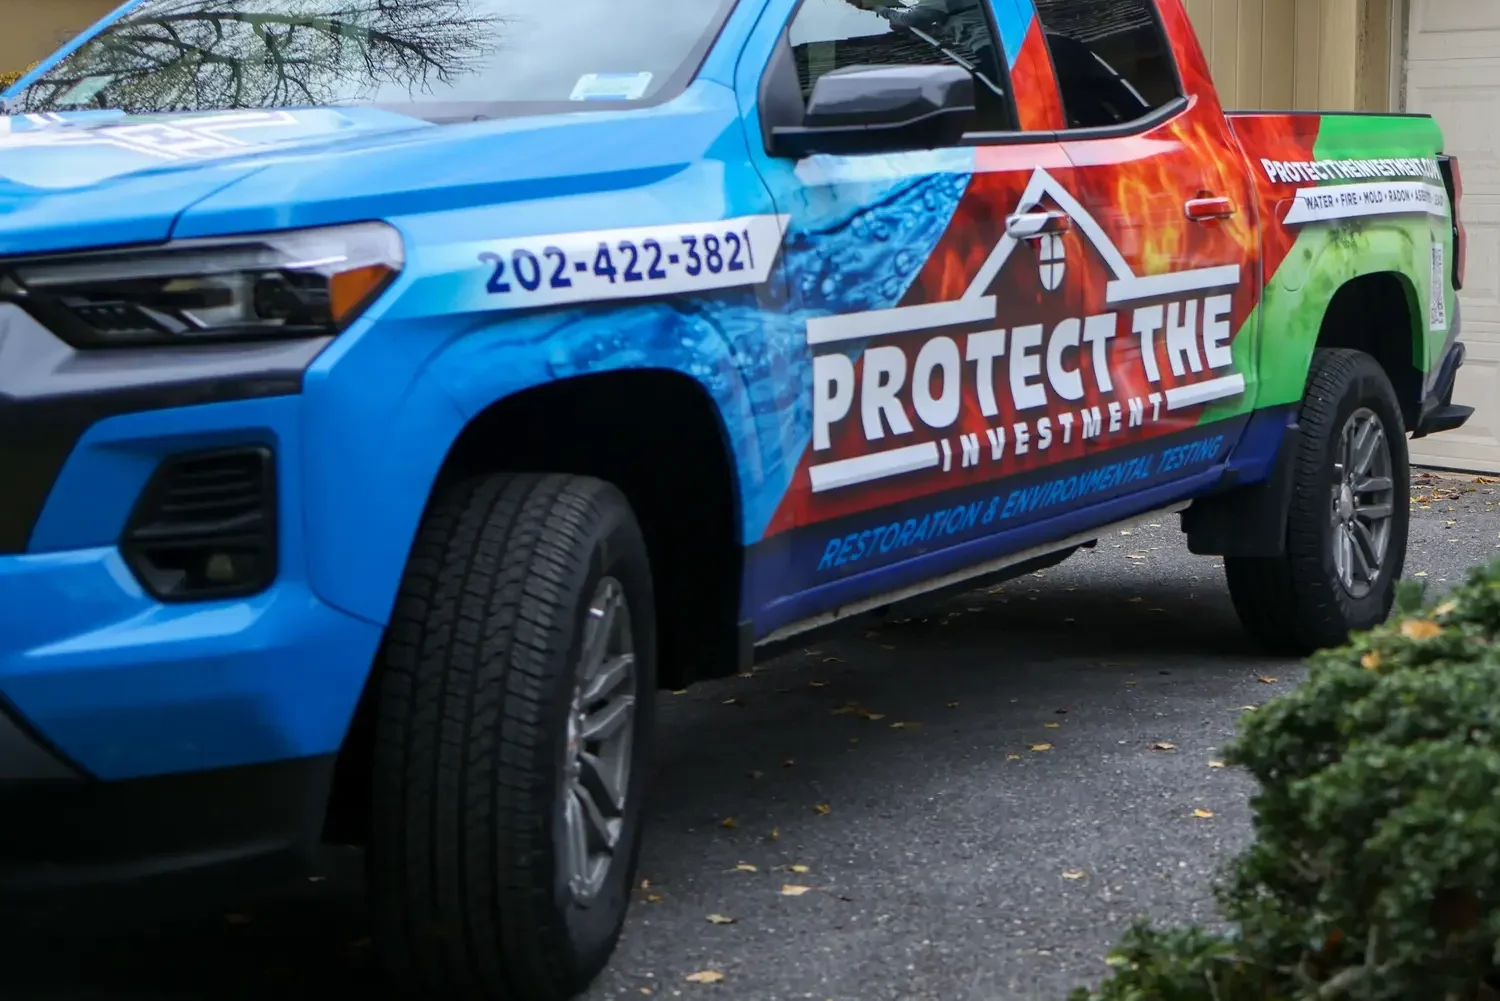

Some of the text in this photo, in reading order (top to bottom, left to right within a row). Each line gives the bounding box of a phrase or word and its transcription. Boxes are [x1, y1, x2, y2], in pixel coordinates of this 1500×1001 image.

[1304, 194, 1333, 210] WATER
[1341, 192, 1358, 206] FIRE
[1363, 190, 1383, 204] MOLD
[1388, 189, 1410, 203] RADON
[477, 229, 754, 294] 202-422-3821
[812, 294, 1233, 451] PROTECT THE
[941, 393, 1163, 472] INVESTMENT
[817, 434, 1225, 571] RESTORATION & ENVIRONMENTAL TESTING
